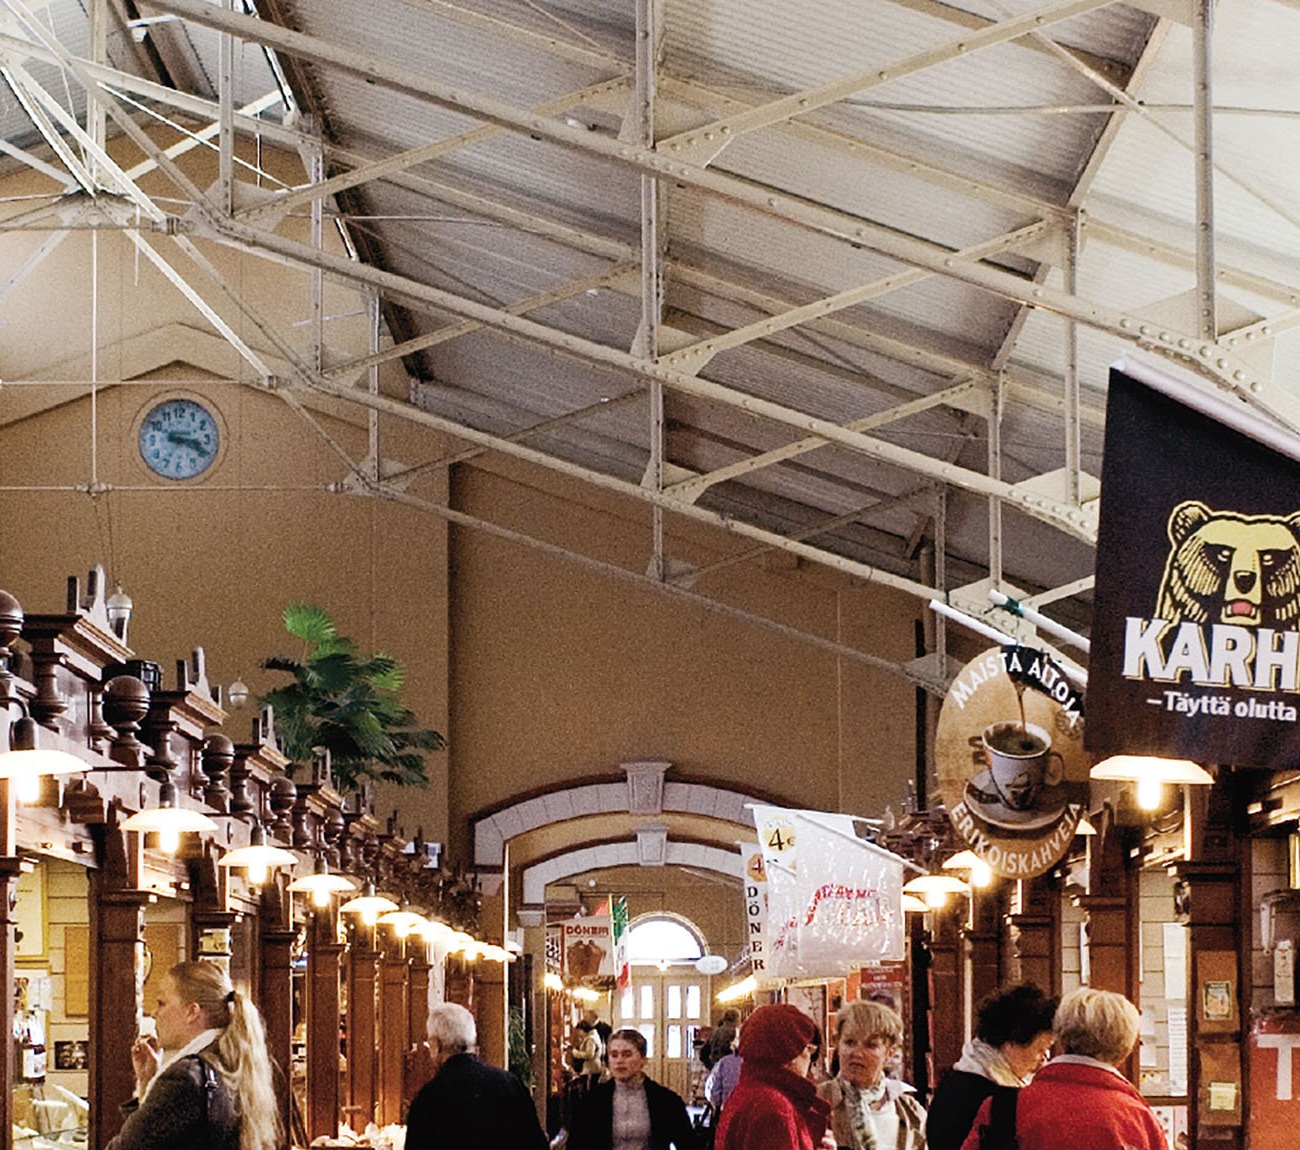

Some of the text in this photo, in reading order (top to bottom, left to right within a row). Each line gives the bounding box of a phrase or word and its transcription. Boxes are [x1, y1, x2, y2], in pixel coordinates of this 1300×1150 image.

[951, 652, 1081, 729] MAISTA AITOJA
[1163, 691, 1297, 722] Täyttä olutta
[951, 802, 1082, 875] ERIKOISKAHVEJA
[747, 886, 765, 970] DÖNER
